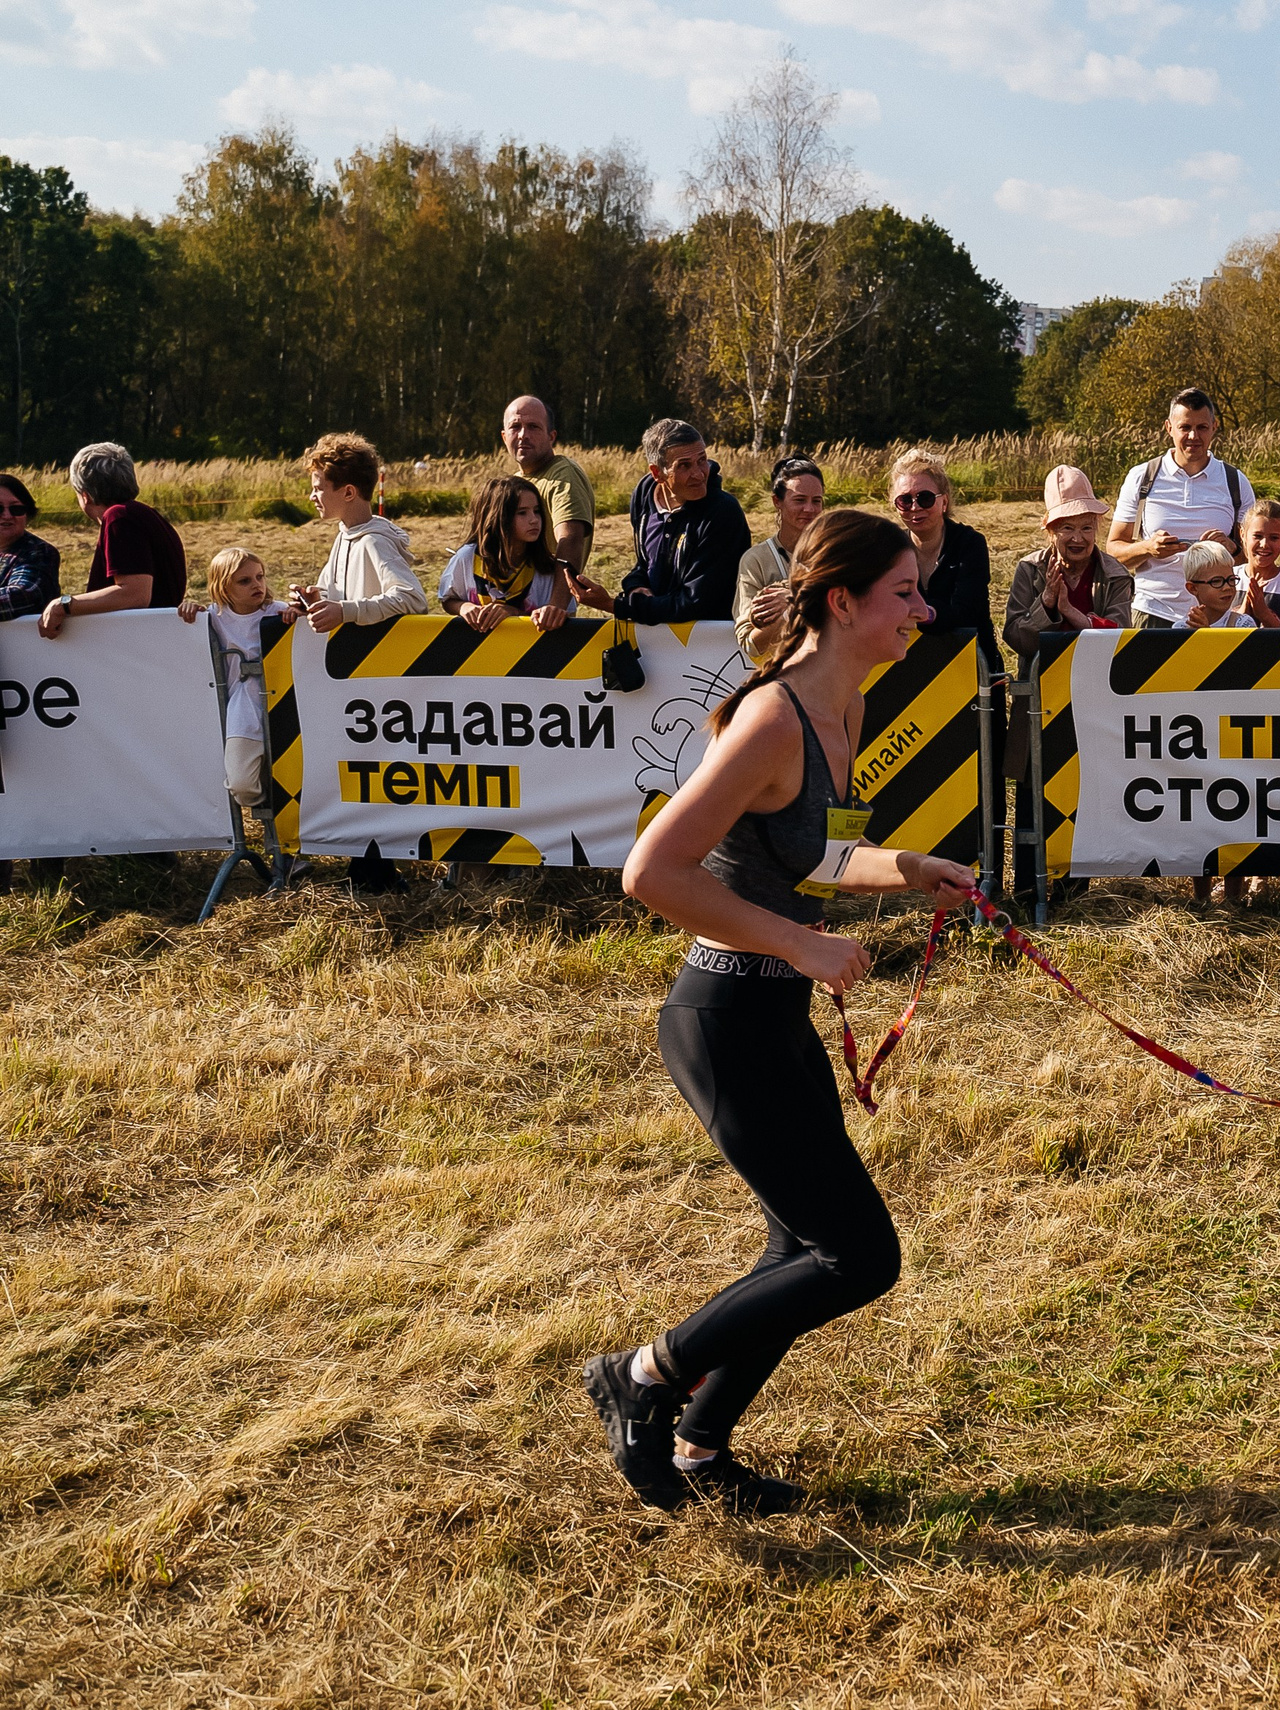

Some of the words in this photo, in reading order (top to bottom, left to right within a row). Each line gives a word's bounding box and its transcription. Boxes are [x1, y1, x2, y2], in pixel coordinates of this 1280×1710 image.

[344, 691, 616, 756] задавай
[1123, 713, 1208, 761] на
[346, 760, 512, 808] темп
